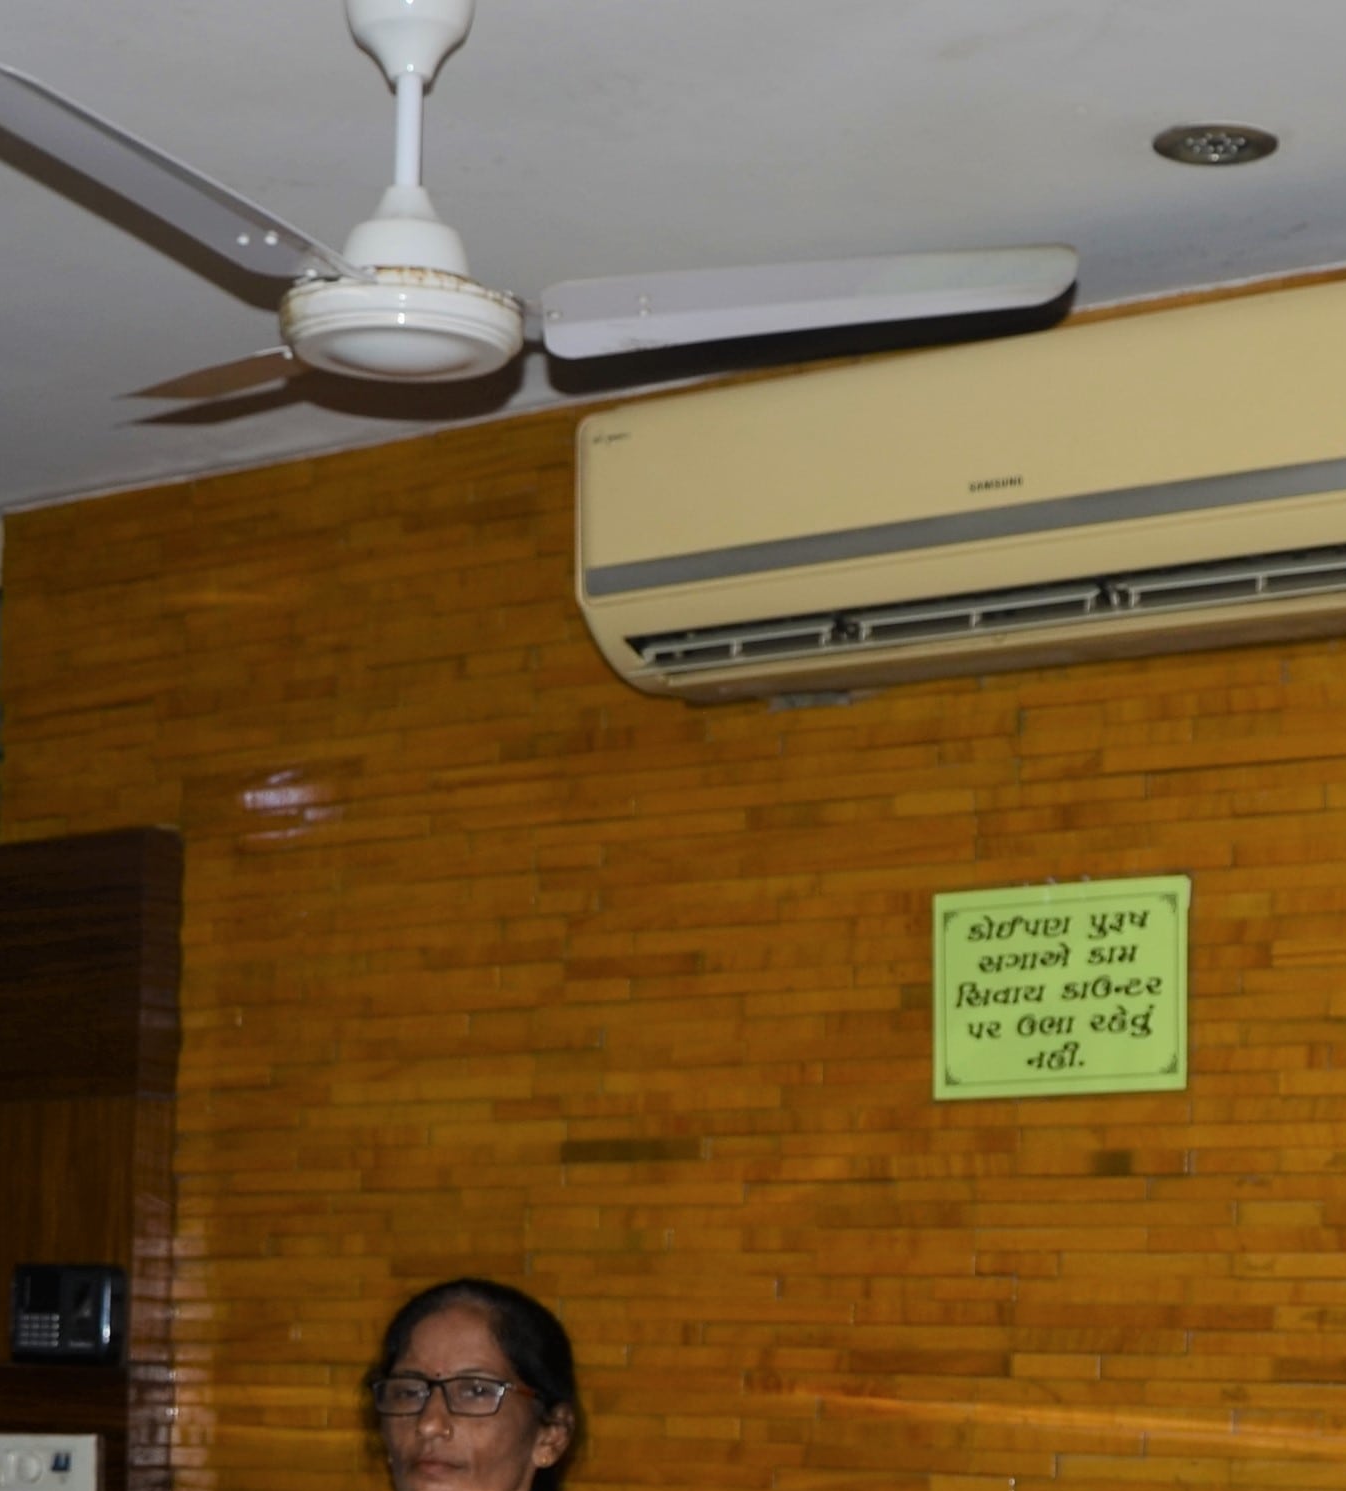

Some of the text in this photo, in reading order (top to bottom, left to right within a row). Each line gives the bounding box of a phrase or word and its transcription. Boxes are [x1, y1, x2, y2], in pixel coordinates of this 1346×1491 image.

[967, 914, 1071, 943] કોઈપણ
[978, 942, 1138, 974] સગાએ કામ
[955, 981, 1046, 1009] સિવાય
[967, 1019, 1002, 1041] પર
